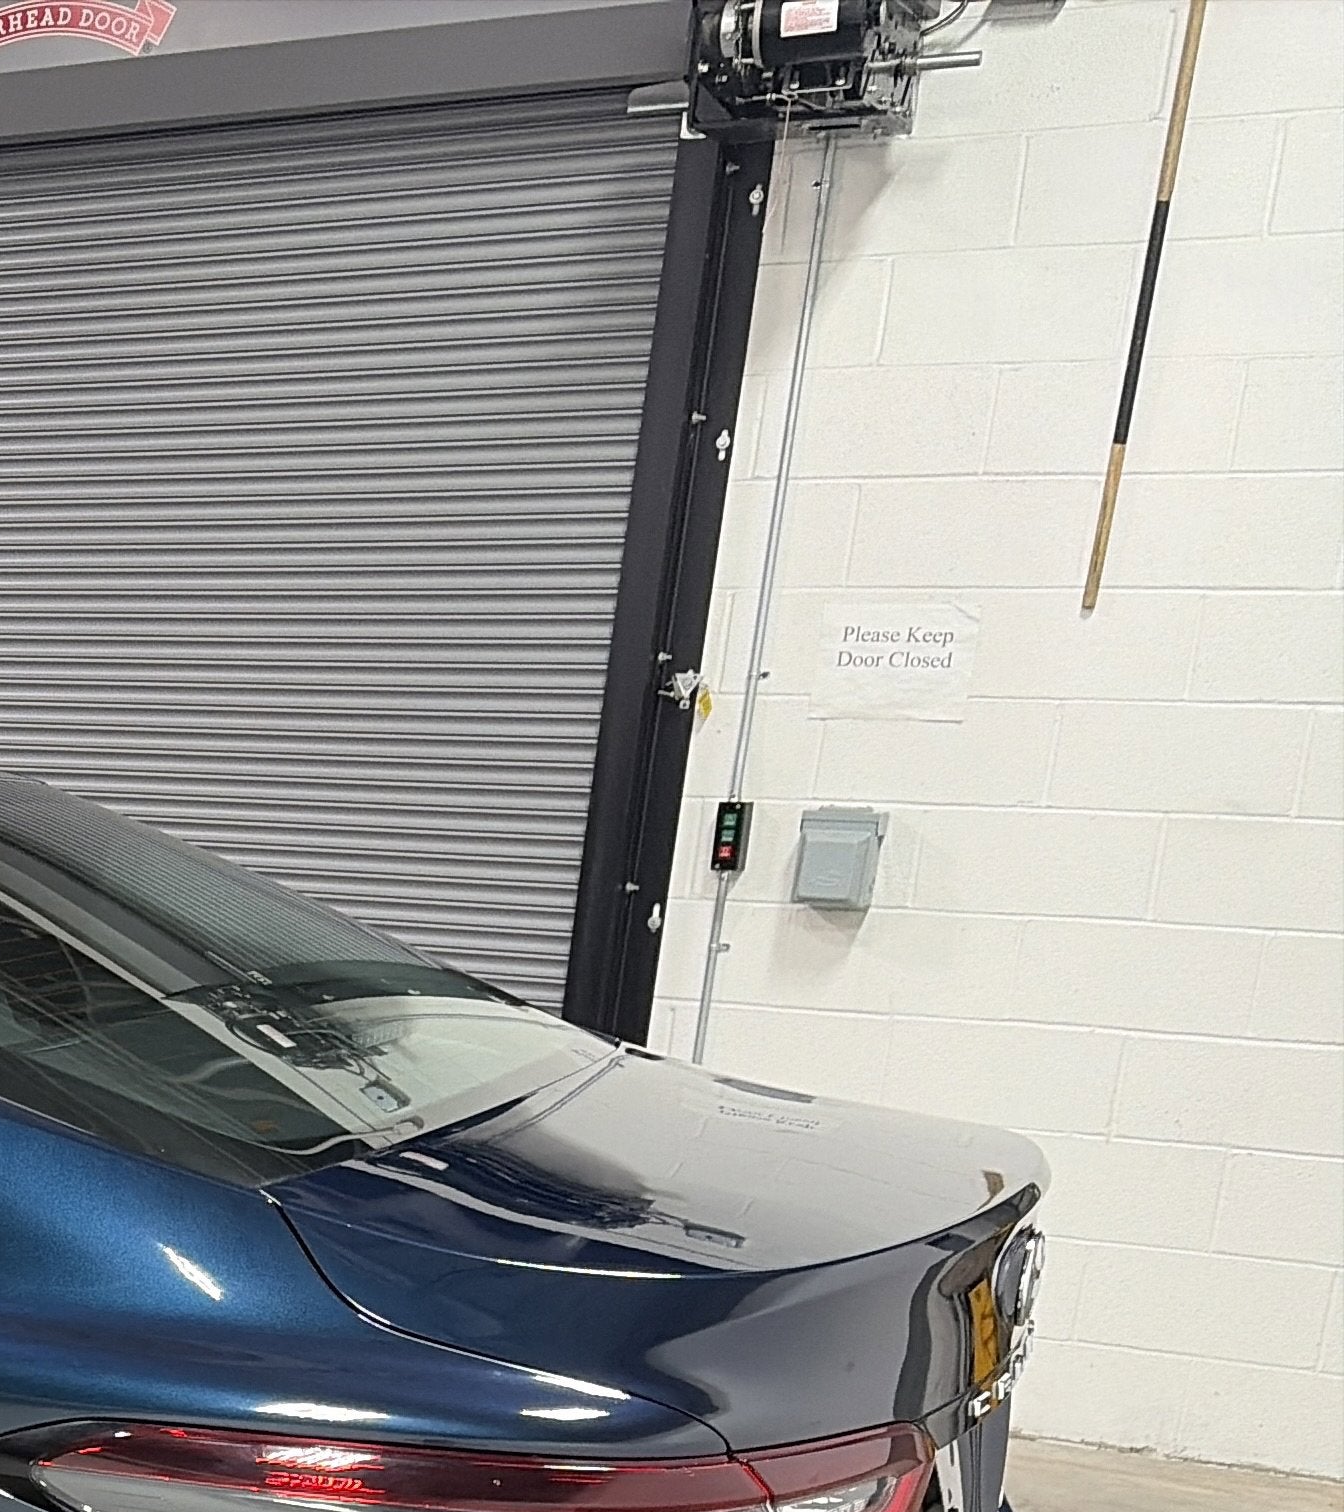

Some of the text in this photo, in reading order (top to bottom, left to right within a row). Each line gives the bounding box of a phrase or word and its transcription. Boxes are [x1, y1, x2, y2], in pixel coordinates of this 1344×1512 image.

[79, 11, 140, 42] DOOR
[842, 625, 954, 647] Please Keep
[836, 650, 953, 668] Door Closed
